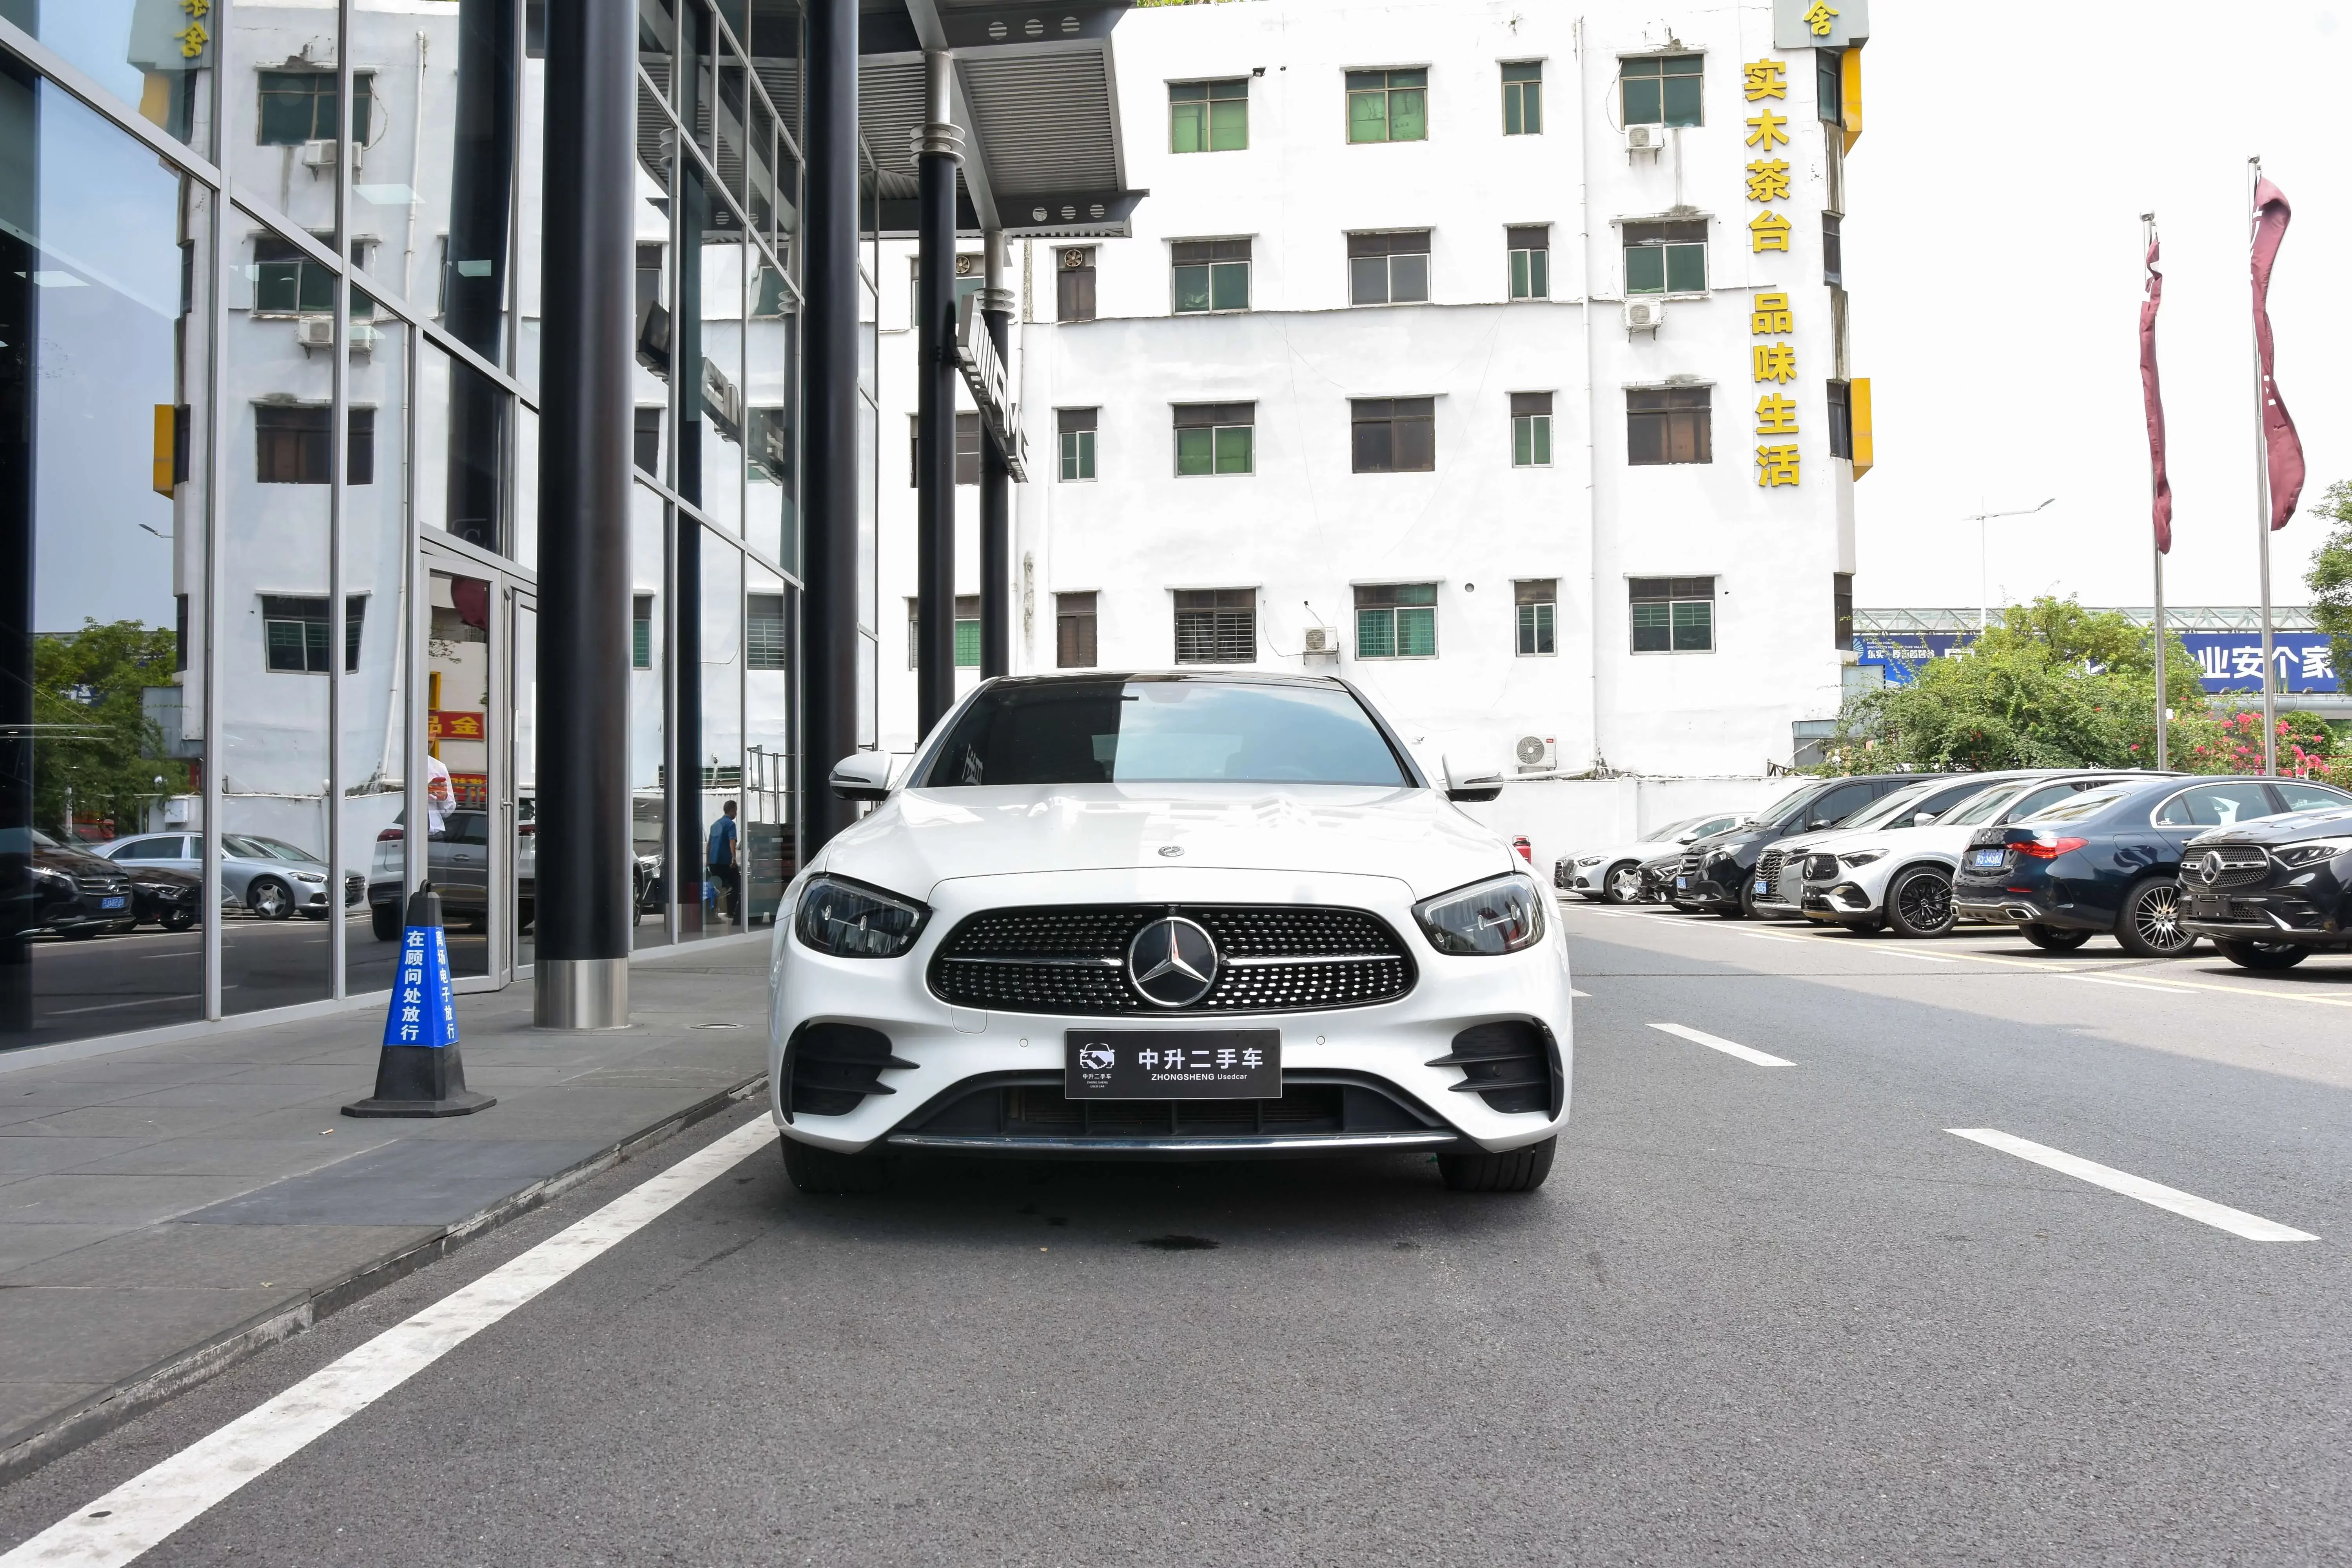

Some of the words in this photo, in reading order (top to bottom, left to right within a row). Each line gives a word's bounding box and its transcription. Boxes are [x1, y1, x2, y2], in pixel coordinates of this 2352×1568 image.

[1804, 0, 1840, 36] 舍
[1744, 58, 1792, 253] 实木茶台
[1752, 292, 1800, 487] 品味生活
[401, 930, 425, 1041] 在顾问处放行
[436, 930, 454, 1039] 离场电子放行
[1139, 1048, 1263, 1069] 中升二手车
